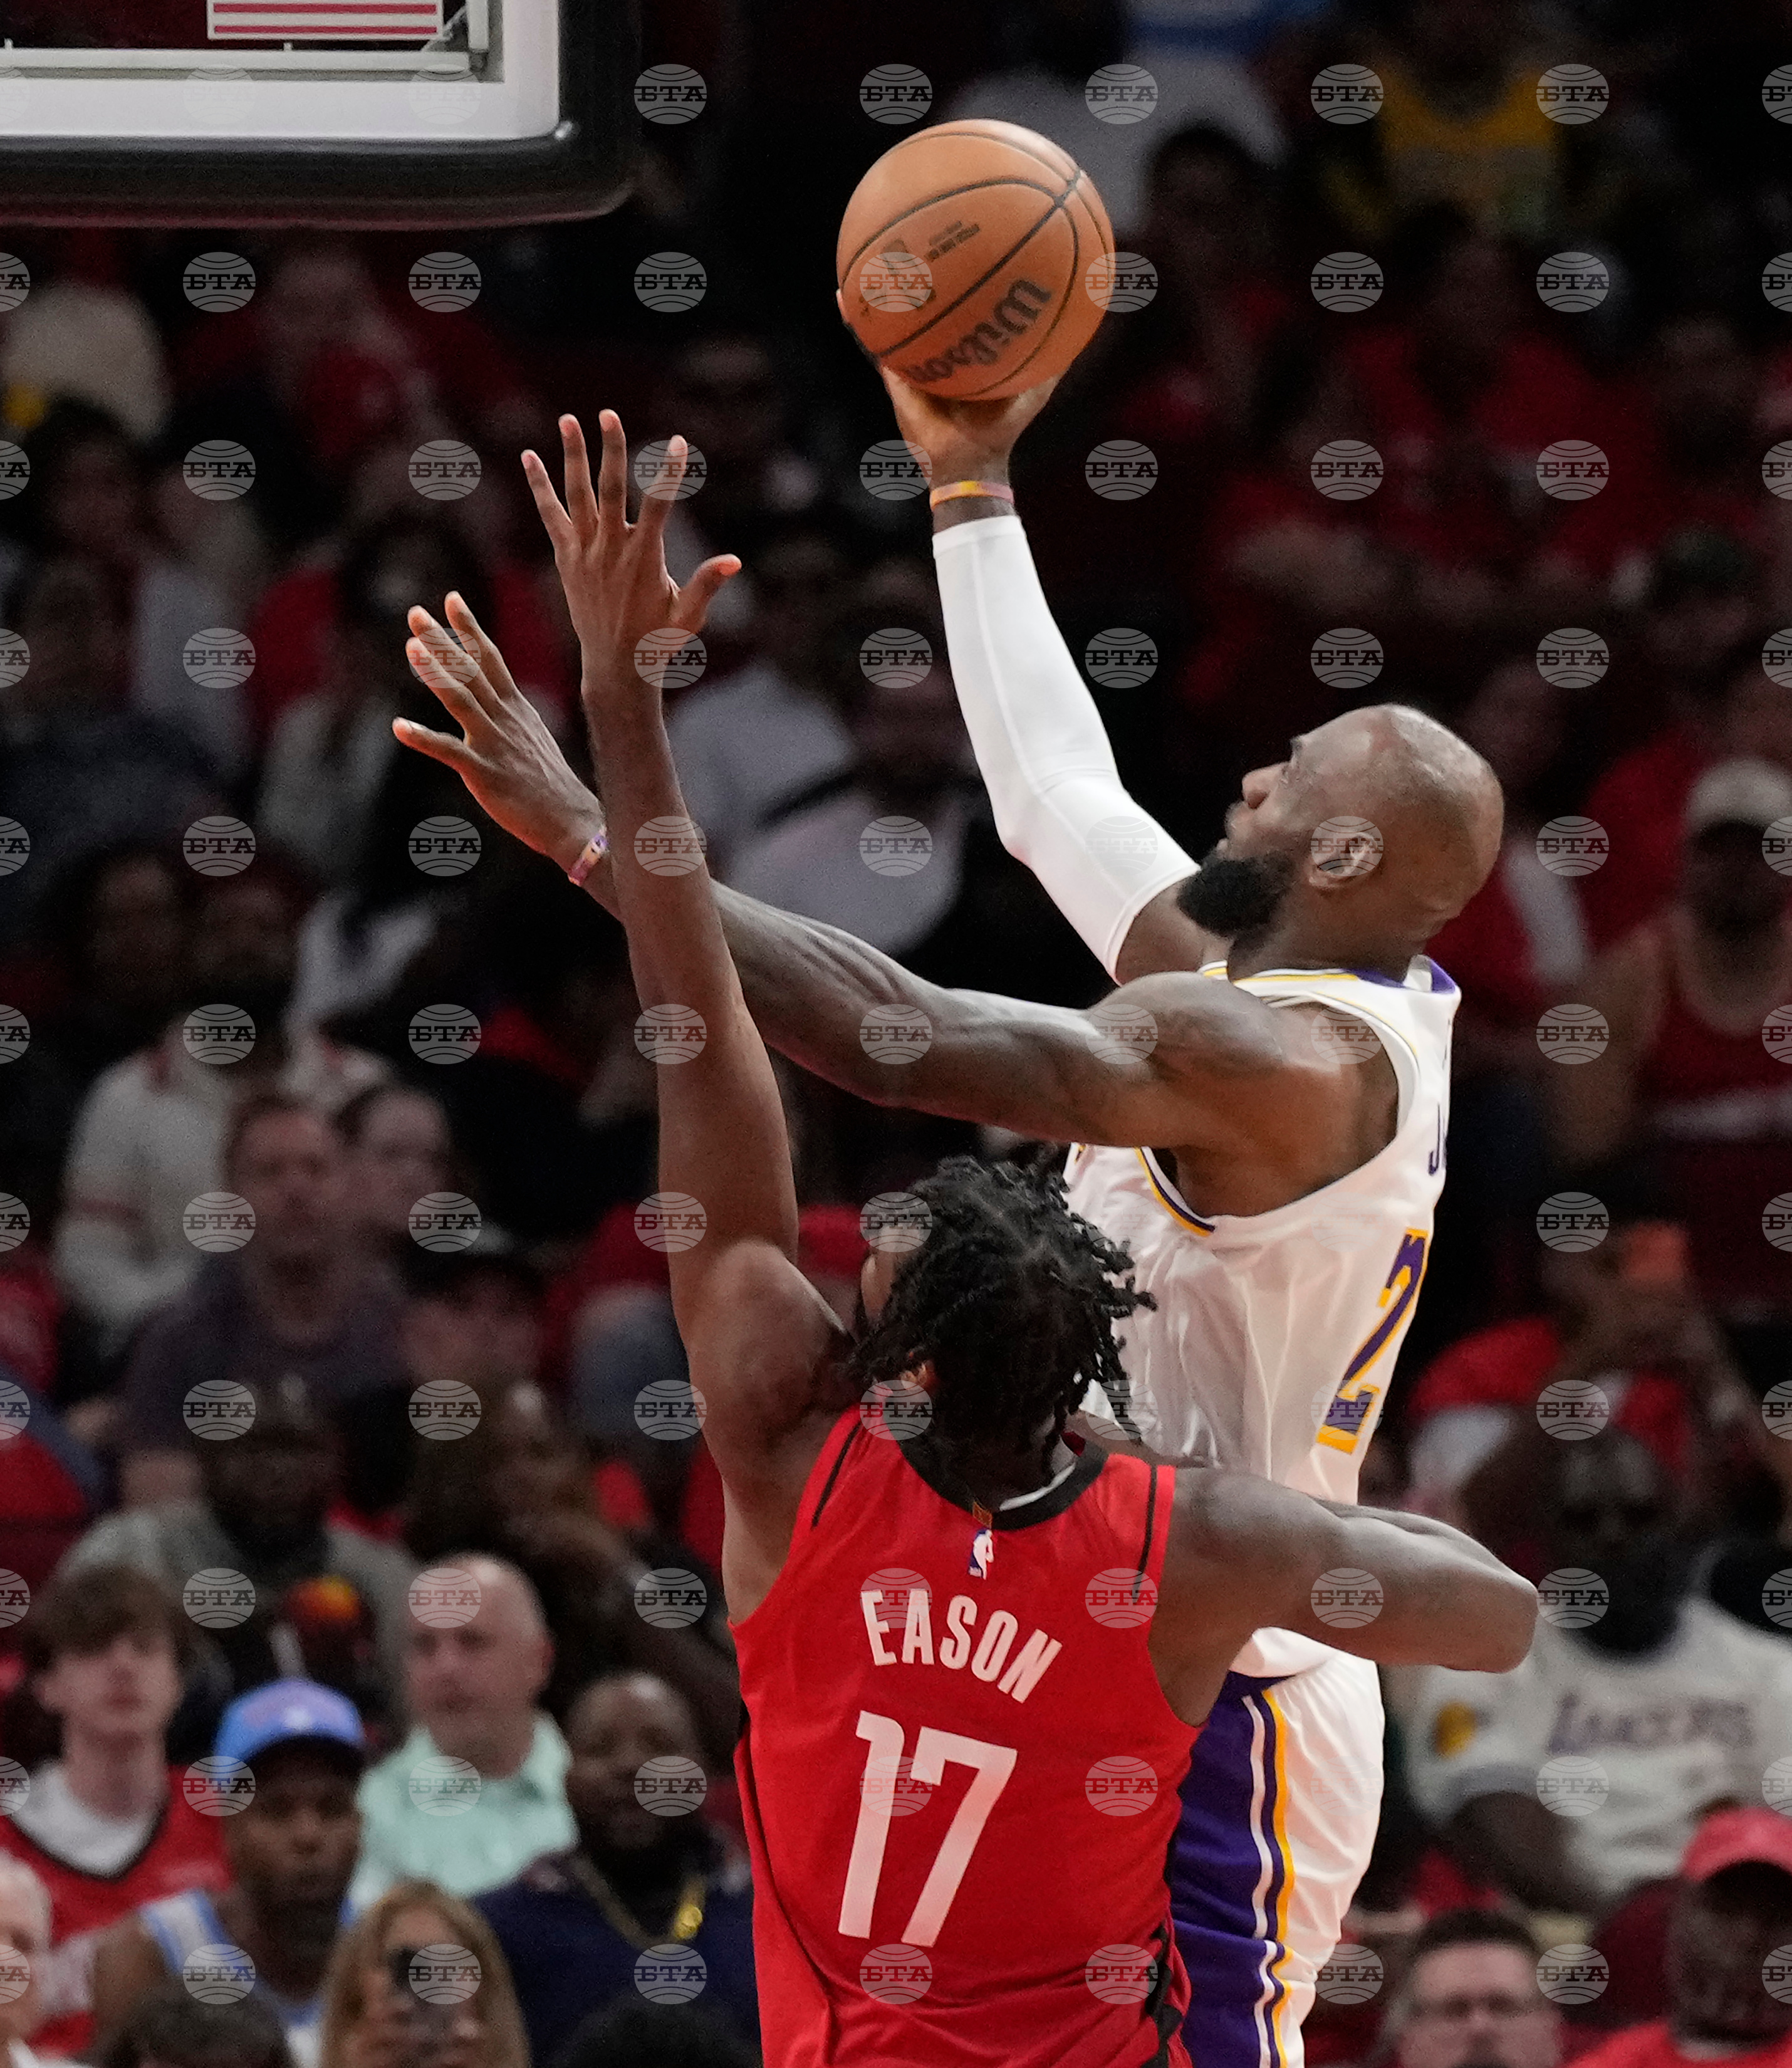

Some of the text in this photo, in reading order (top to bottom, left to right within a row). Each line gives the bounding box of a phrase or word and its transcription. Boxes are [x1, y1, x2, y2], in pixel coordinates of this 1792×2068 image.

[903, 280, 1051, 384] Wilson
[861, 1588, 1062, 1703] EASON
[838, 1710, 1017, 1947] 17
